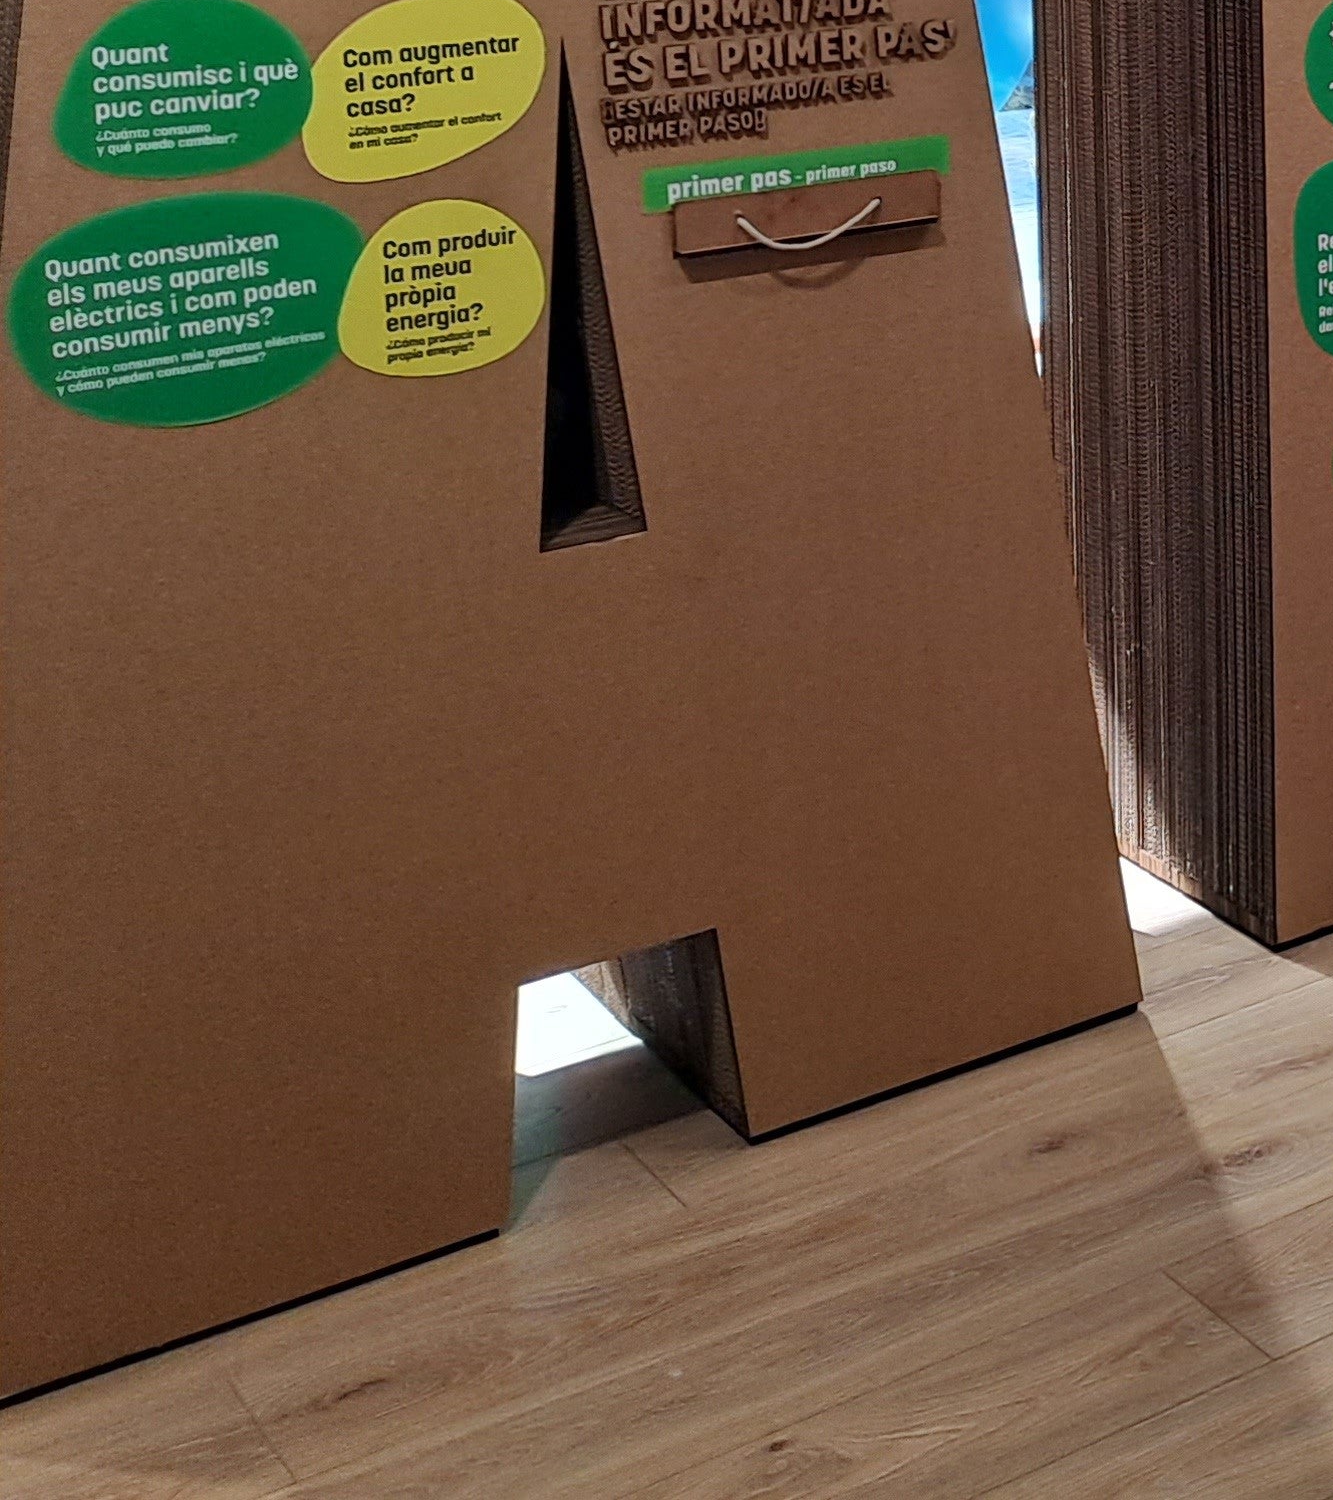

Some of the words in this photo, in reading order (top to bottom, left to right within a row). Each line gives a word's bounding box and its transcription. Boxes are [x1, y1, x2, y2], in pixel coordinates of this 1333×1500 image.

[91, 43, 169, 70] Quant
[343, 49, 392, 68] Com
[400, 37, 520, 64] augmentar
[602, 41, 654, 94] ÉS
[663, 42, 710, 89] EL
[718, 28, 866, 83] PRIMER
[93, 65, 233, 93] consumisc
[239, 61, 246, 82] i
[253, 59, 299, 86] què
[345, 72, 365, 93] el
[372, 66, 455, 90] confort
[461, 66, 474, 81] a
[95, 100, 143, 125] puc
[150, 87, 261, 115] canviar?
[346, 93, 416, 118] casa?
[686, 77, 839, 119] INFORMADO/A
[839, 76, 865, 102] ES
[868, 72, 894, 100] EL
[605, 119, 696, 156] PRIMER
[667, 174, 745, 205] primer
[750, 168, 792, 192] pas
[805, 163, 856, 184] primer
[860, 159, 897, 178] paso
[44, 252, 121, 282] Quant
[128, 233, 279, 269] consumixen
[383, 240, 431, 259] Com
[438, 226, 517, 257] produir
[384, 264, 404, 284] la
[411, 259, 472, 281] meua
[1318, 257, 1333, 274] el
[47, 283, 86, 308] els
[93, 274, 163, 300] meus
[169, 258, 270, 291] aparells
[385, 282, 457, 313] pròpia
[50, 300, 164, 333] elèctrics
[170, 293, 178, 314] i
[185, 290, 236, 313] com
[243, 278, 317, 310] poden
[386, 303, 484, 332] energia?
[52, 322, 172, 359] consumir
[179, 306, 274, 339] menys?
